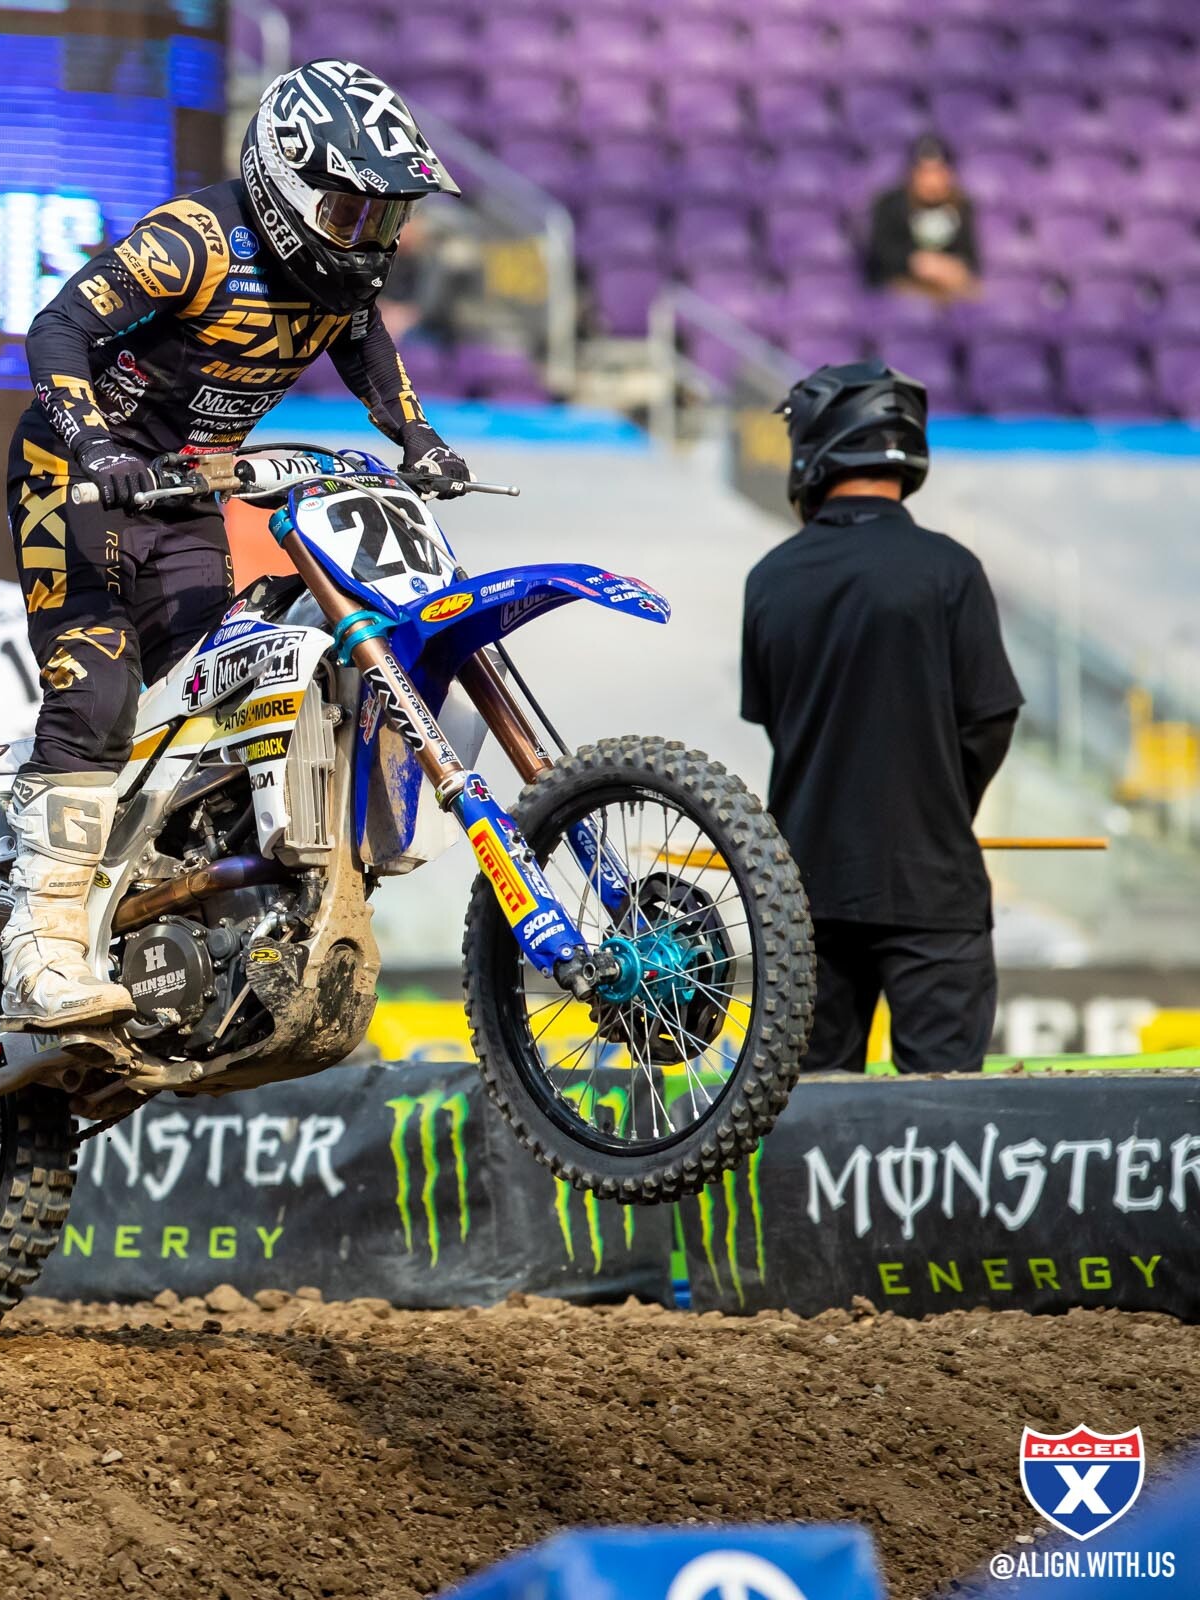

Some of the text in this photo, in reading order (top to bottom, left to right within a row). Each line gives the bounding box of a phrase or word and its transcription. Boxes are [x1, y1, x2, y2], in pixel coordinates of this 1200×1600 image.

[77, 274, 124, 317] 26
[239, 281, 269, 295] YAMAHA
[326, 495, 442, 583] 26
[488, 579, 516, 594] YAMAHA
[421, 593, 473, 622] FMF
[222, 621, 257, 642] YAMAHA
[471, 828, 528, 914] PIRELLI
[523, 909, 561, 940] SKDA
[131, 968, 186, 996] HINSON
[70, 1098, 345, 1201] NSTER
[62, 1224, 284, 1260] NERGY
[878, 1254, 1163, 1297] ENERGY
